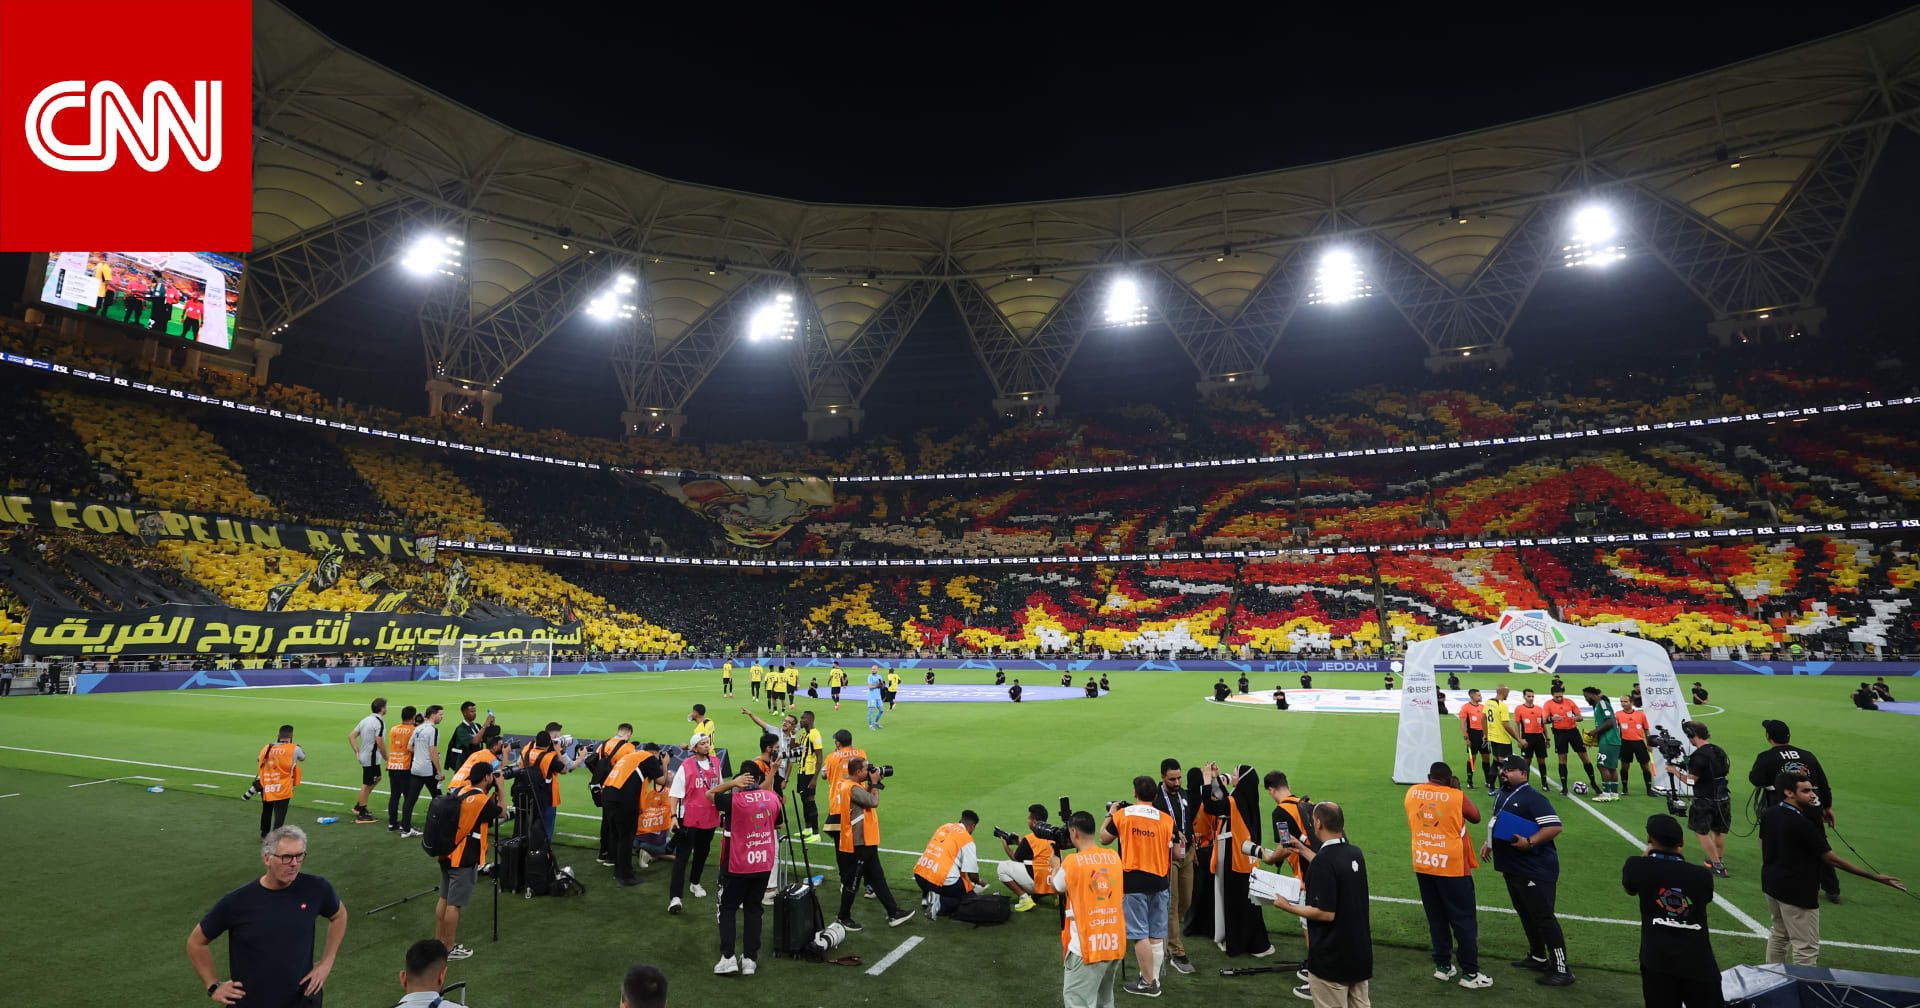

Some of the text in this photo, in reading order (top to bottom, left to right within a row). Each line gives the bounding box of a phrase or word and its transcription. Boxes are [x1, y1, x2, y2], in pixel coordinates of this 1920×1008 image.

[53, 365, 68, 374] RSL
[114, 378, 128, 387] RSL
[170, 390, 183, 398] RSL
[223, 401, 235, 409] RSL
[270, 410, 282, 418] RSL
[1540, 433, 1552, 441] RSL
[1637, 424, 1650, 432] RSL
[1690, 419, 1704, 427] RSL
[1746, 413, 1760, 421] RSL
[1803, 408, 1819, 416] RSL
[1866, 401, 1883, 409] RSL
[216, 519, 282, 548] UN
[29, 615, 195, 653] الفريق
[196, 621, 275, 653] روح
[277, 613, 352, 653] أنتم
[375, 620, 461, 652] لاعبين
[526, 626, 582, 650] لستم
[1516, 635, 1543, 647] RSL
[1603, 641, 1623, 650] دوري
[1442, 650, 1484, 660] LEAGUE
[1580, 649, 1625, 661] السعودي
[1318, 662, 1377, 671] JEDDAH
[1656, 687, 1675, 695] BSF
[1487, 709, 1494, 722] 8
[1780, 751, 1800, 760] HB
[744, 791, 771, 803] SPL
[1412, 789, 1450, 801] PHOTO
[1132, 827, 1155, 838] Photo
[747, 850, 767, 864] 091
[1075, 853, 1117, 866] PHOTO
[1415, 850, 1449, 868] 2267
[1088, 933, 1119, 952] 1703
